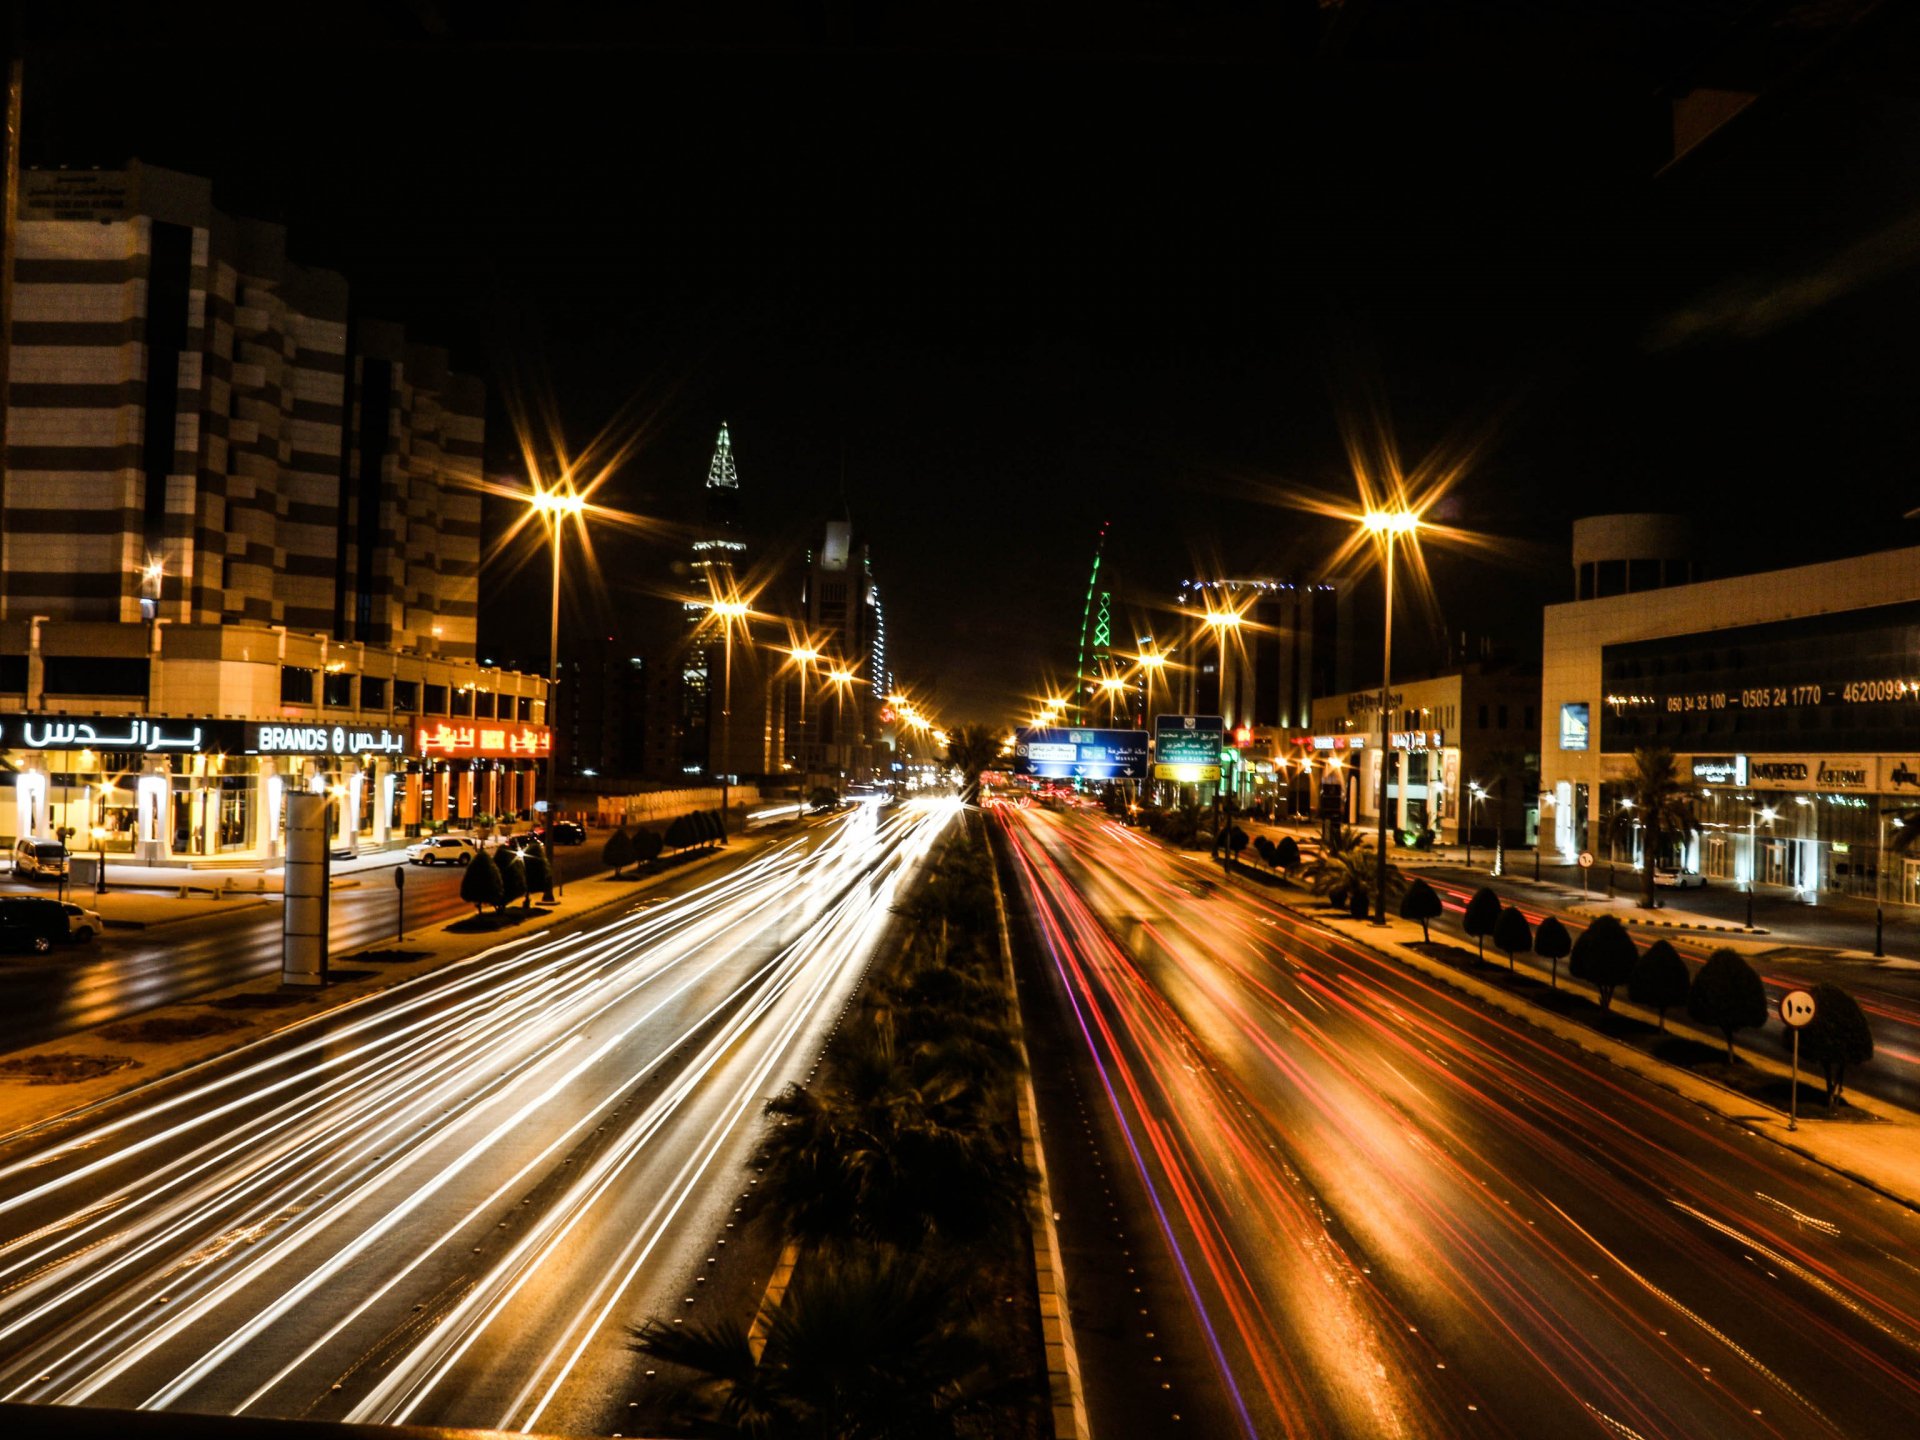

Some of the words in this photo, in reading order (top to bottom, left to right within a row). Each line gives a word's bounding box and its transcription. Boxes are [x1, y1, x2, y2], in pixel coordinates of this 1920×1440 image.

[1667, 698, 1682, 712] 050
[1684, 697, 1695, 711] 34
[1697, 696, 1708, 710] 32
[1710, 694, 1726, 709] 100
[1742, 689, 1770, 708] 0505
[1774, 688, 1788, 706] 24
[1792, 685, 1821, 706] 1770
[1842, 679, 1904, 703] 4620099
[24, 720, 202, 752] براندس
[259, 727, 328, 751] BRANDS
[349, 729, 403, 754] براندس
